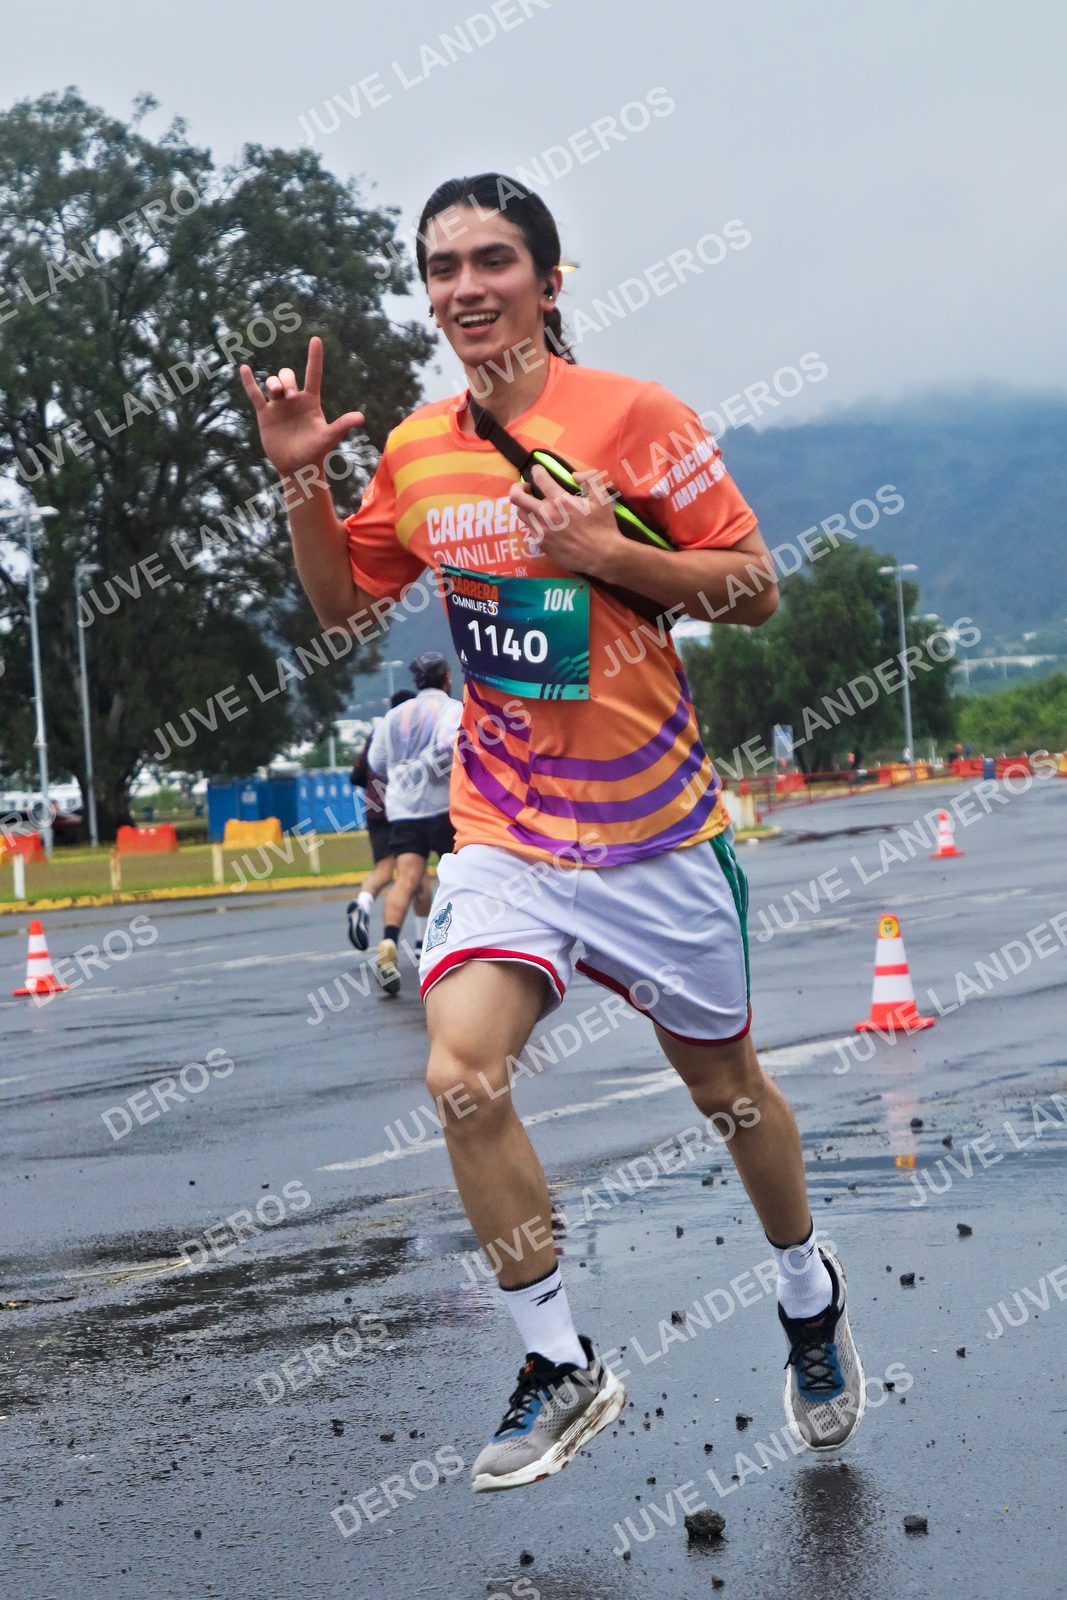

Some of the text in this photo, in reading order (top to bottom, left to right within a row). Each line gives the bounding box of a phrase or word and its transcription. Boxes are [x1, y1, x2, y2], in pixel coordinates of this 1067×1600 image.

[427, 496, 525, 545] CARRE
[451, 575, 498, 601] CARRERA
[543, 588, 577, 612] 10K
[467, 619, 549, 664] 1140
